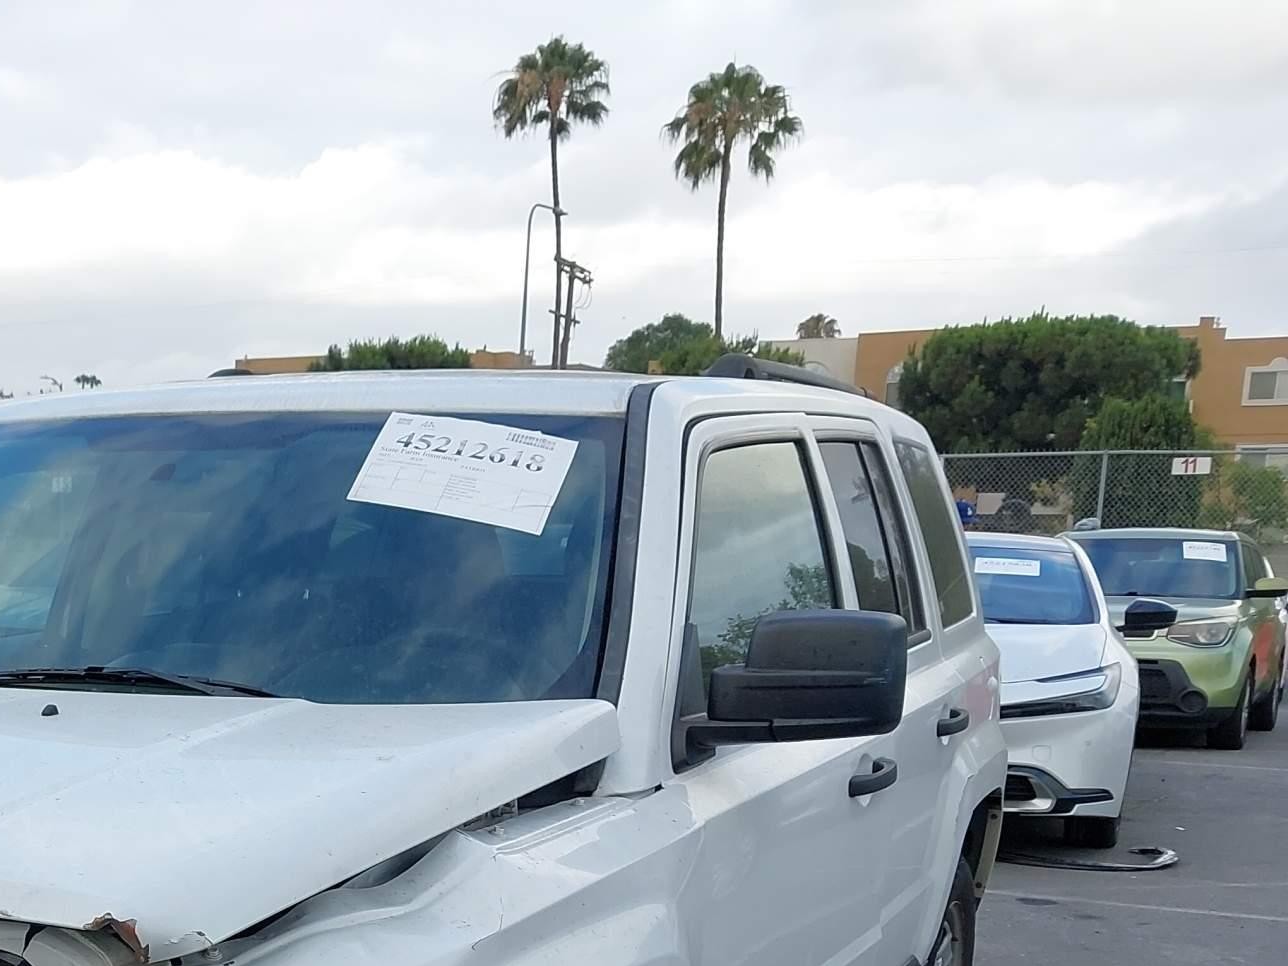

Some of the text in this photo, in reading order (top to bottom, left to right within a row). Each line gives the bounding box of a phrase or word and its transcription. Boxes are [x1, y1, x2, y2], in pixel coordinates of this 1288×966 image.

[396, 431, 546, 473] 45212618
[422, 450, 459, 463] Insurance
[1181, 458, 1197, 473] 11
